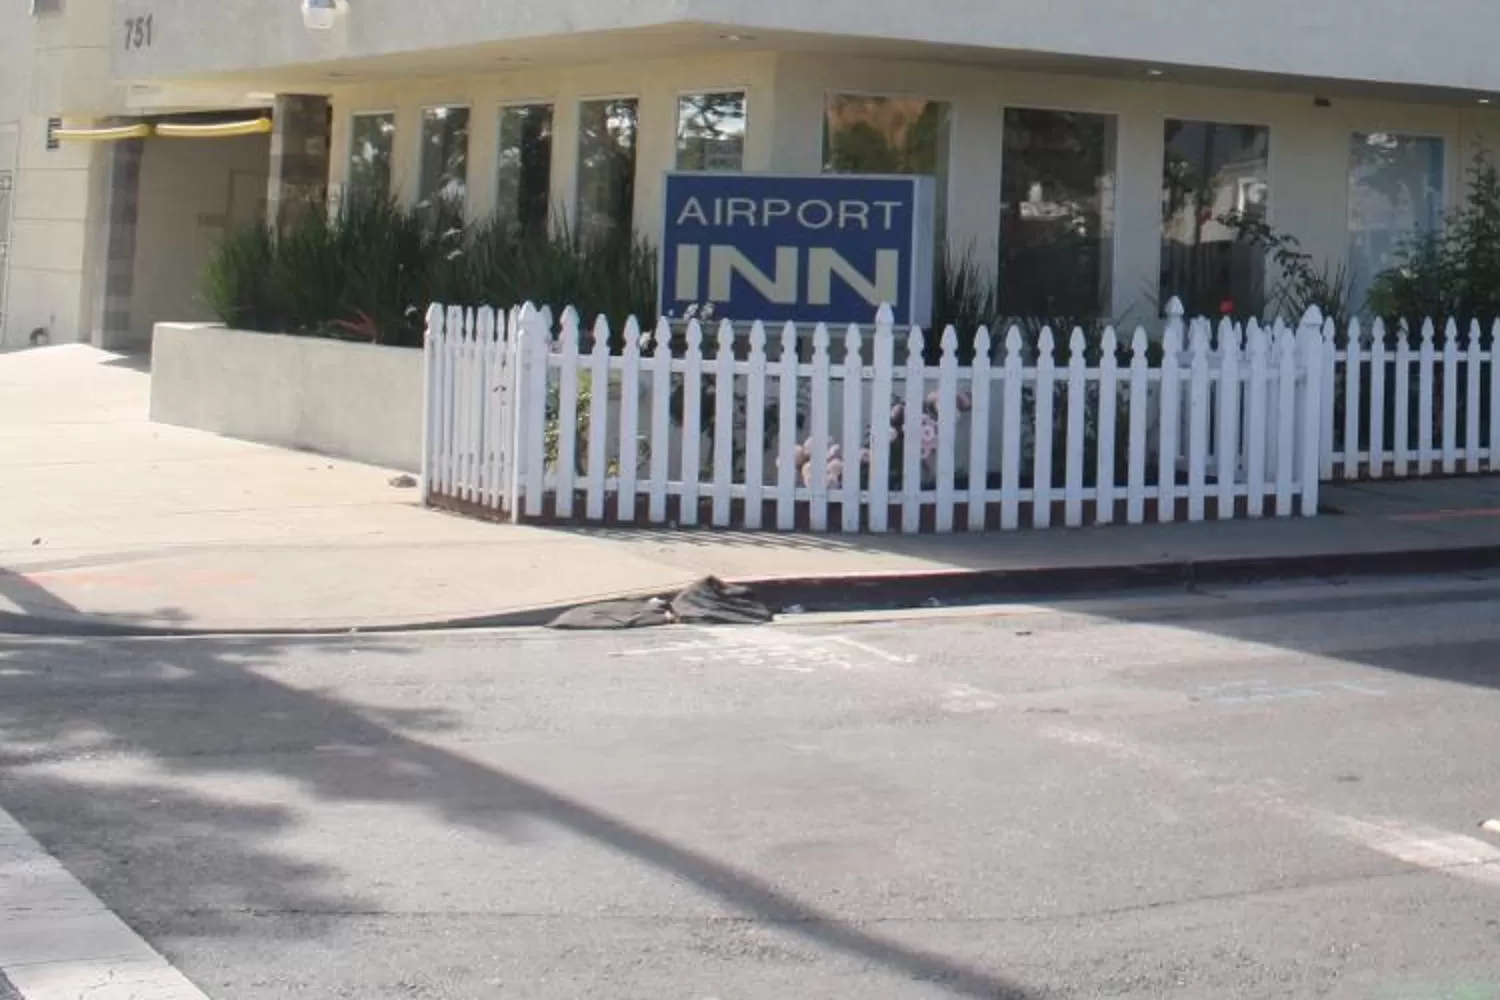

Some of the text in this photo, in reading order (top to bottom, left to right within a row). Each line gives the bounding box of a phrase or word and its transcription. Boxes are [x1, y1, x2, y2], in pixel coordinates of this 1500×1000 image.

[124, 13, 153, 50] 751
[676, 195, 903, 231] AIRPORT
[675, 243, 899, 307] INN
